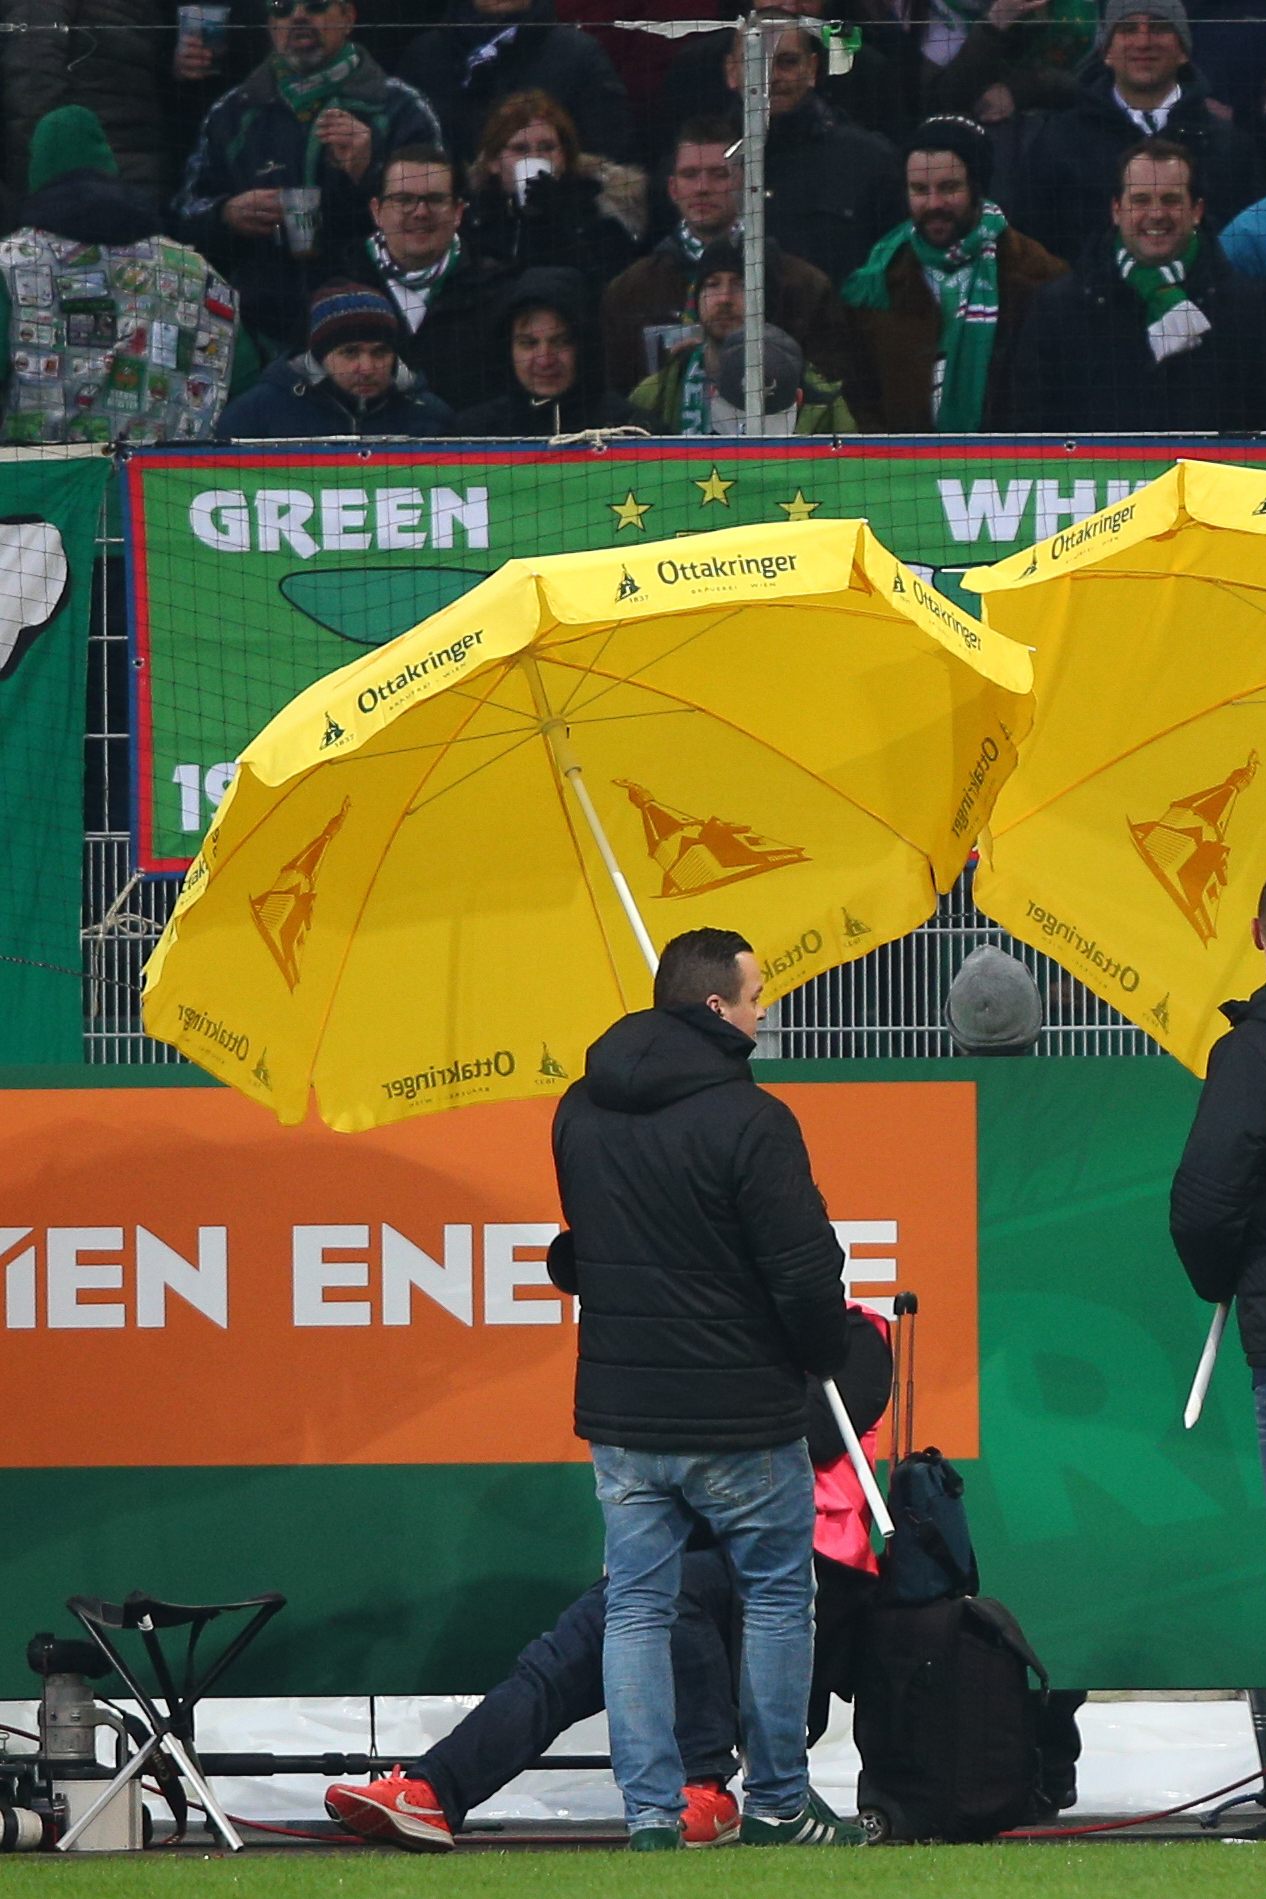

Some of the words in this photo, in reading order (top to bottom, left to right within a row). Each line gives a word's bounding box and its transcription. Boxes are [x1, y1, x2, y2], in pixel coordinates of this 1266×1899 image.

[188, 486, 489, 560] GREEN
[1051, 503, 1136, 560] Ottakringer
[657, 554, 797, 585] Ottakringer
[913, 580, 982, 651] Ottakringer
[357, 629, 484, 714] Ottakringer
